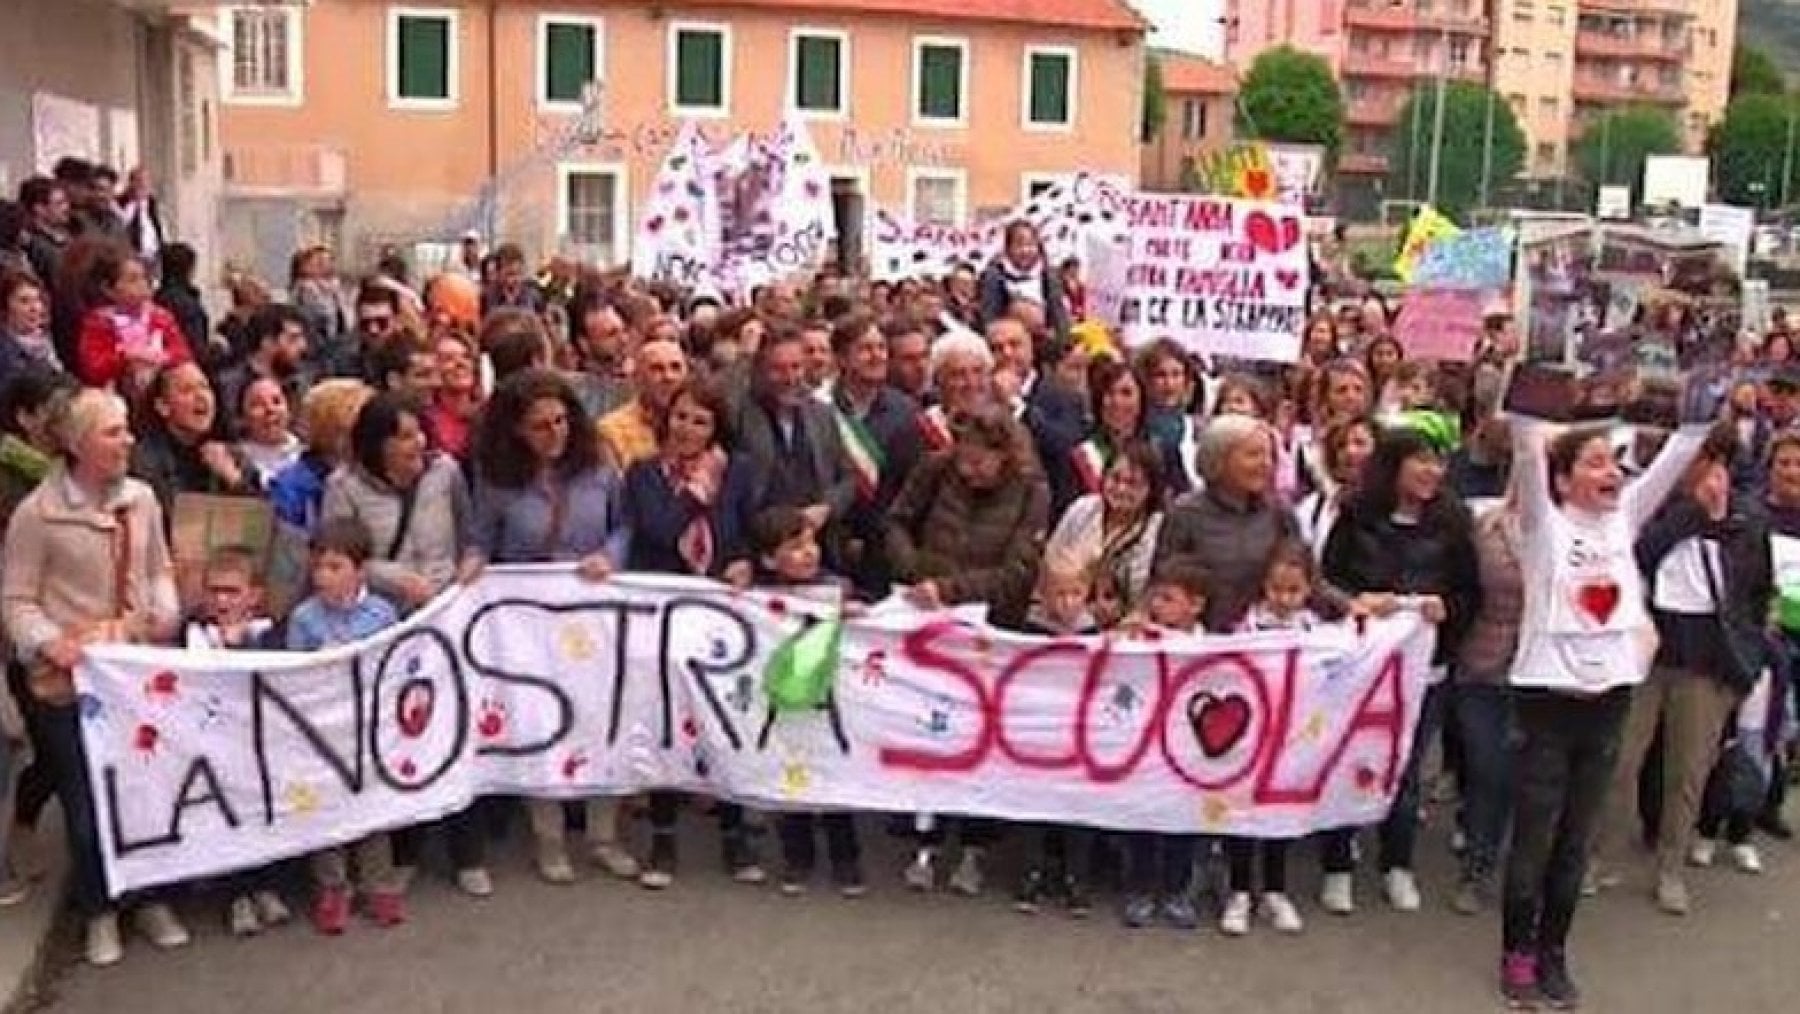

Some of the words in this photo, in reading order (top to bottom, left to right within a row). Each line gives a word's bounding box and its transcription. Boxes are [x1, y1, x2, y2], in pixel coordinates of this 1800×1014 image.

[1181, 297, 1208, 329] LA
[104, 754, 240, 856] LA
[878, 619, 1405, 805] SCUOLA
